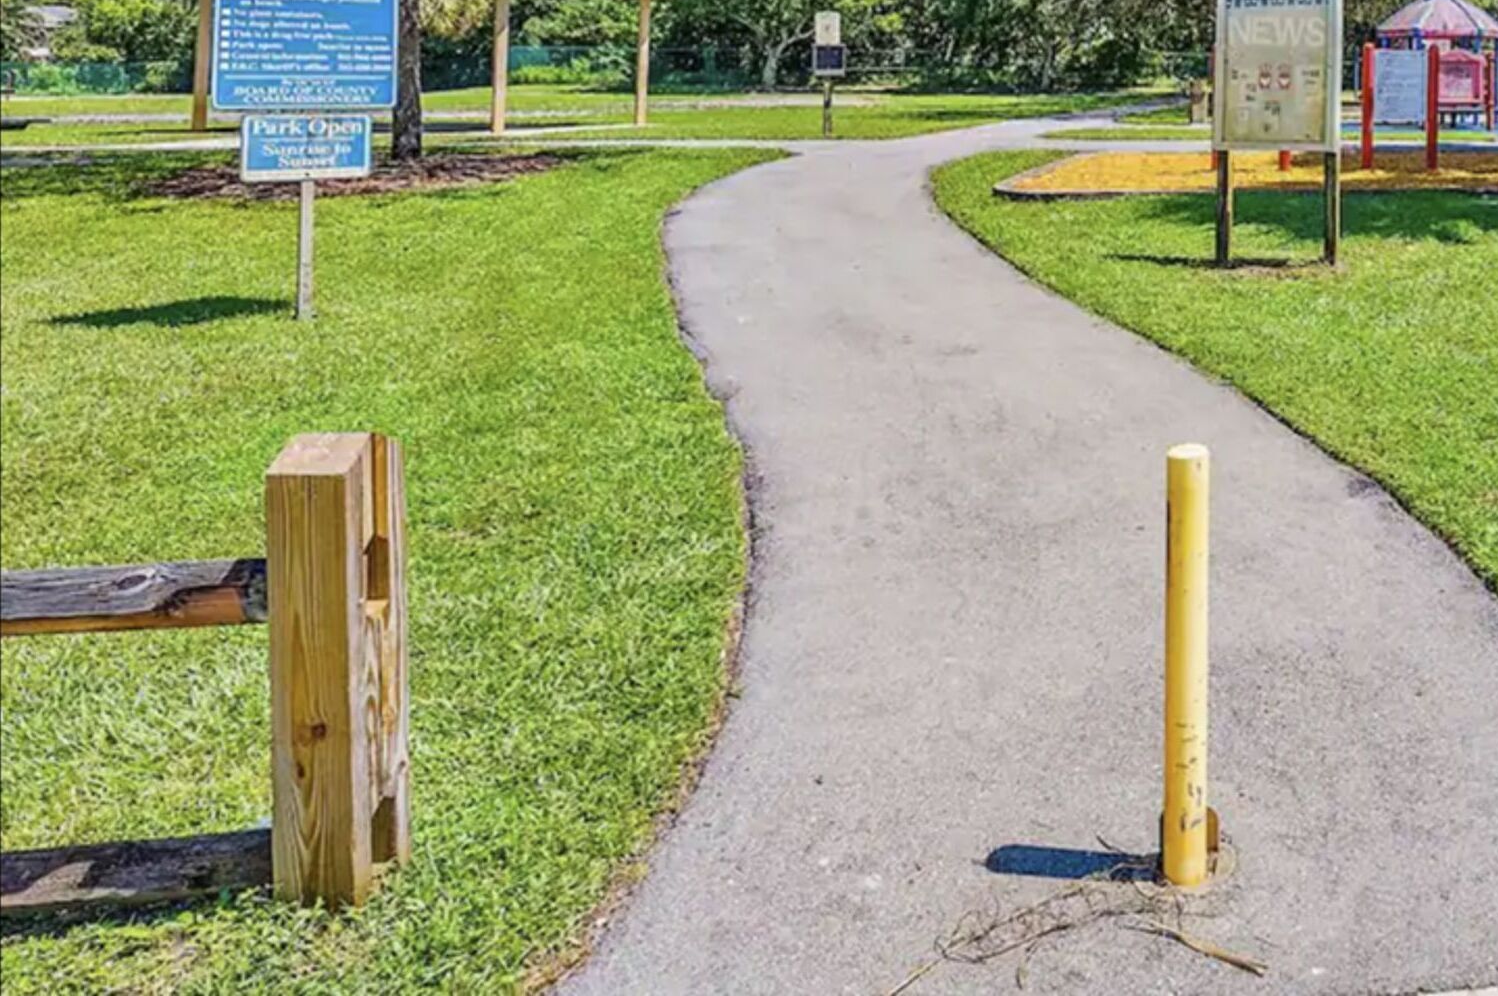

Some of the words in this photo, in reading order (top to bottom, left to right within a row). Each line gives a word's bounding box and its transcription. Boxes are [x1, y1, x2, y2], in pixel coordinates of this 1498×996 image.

[1228, 16, 1327, 47] NEWS
[251, 119, 304, 136] Park
[308, 118, 363, 140] Open
[262, 142, 332, 158] Sunrise
[277, 155, 338, 168] Sunset
